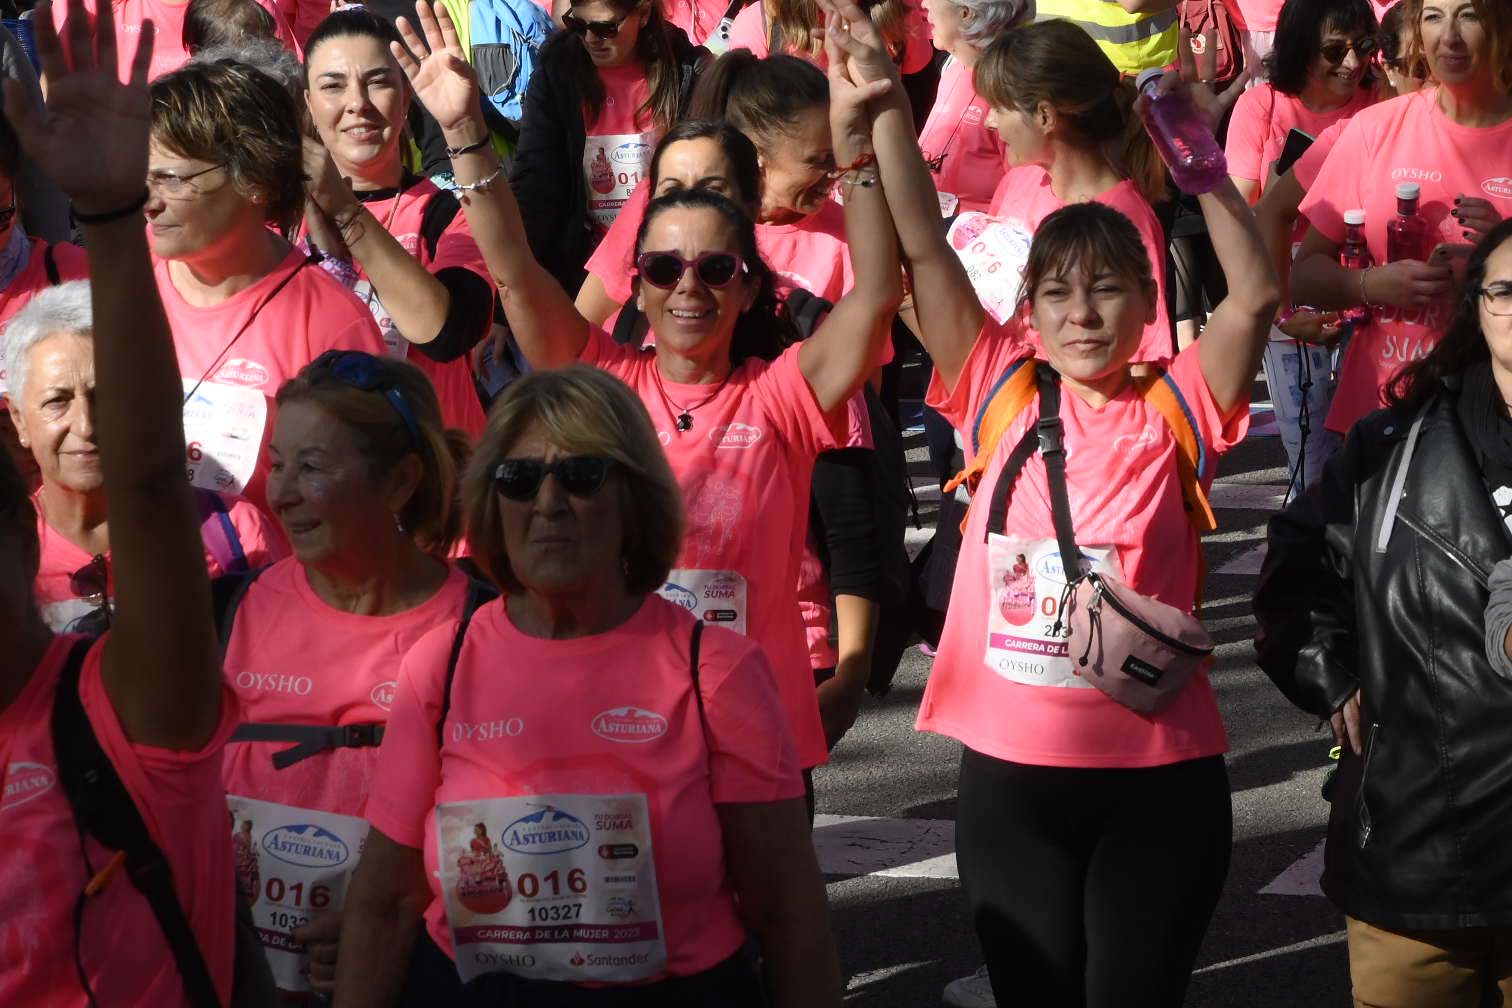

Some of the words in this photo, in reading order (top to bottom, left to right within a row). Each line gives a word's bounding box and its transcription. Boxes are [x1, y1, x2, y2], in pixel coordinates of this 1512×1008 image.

[121, 24, 160, 33] OYSO
[618, 172, 640, 184] 01
[1392, 168, 1442, 182] OYSHO
[1382, 336, 1434, 361] SUM
[704, 590, 736, 599] SUMA
[1005, 639, 1045, 652] CARRERA
[1047, 645, 1059, 654] DE
[999, 658, 1045, 675] OYSHO
[236, 672, 312, 695] OYSHO
[453, 717, 525, 742] OYSHO
[598, 719, 662, 735] ASTURIANA
[596, 820, 633, 831] SUMA
[509, 828, 585, 846] ASTURIANA
[268, 834, 340, 863] ASTURIANA
[517, 867, 588, 898] 016
[265, 877, 331, 909] 016
[527, 903, 583, 922] 10327
[478, 929, 530, 940] CARRERA
[535, 930, 551, 939] DE
[554, 929, 570, 939] LA
[573, 929, 610, 939] MUJER
[475, 952, 536, 968] OYSHO
[587, 953, 649, 967] Santander
